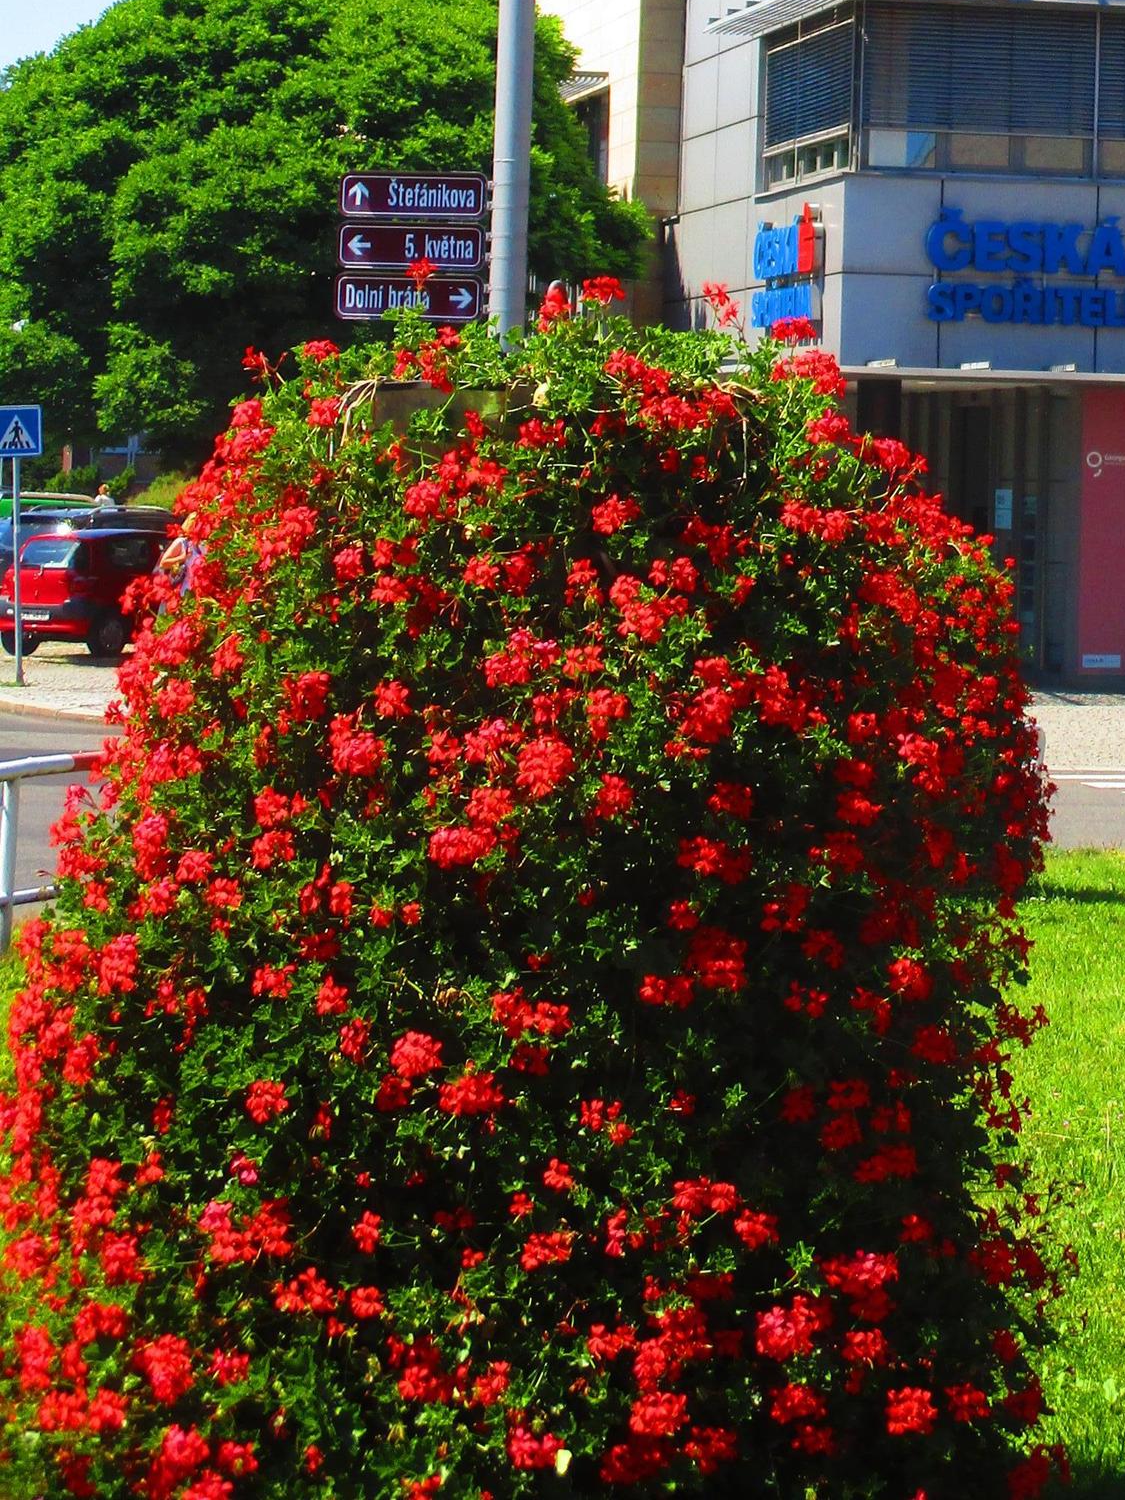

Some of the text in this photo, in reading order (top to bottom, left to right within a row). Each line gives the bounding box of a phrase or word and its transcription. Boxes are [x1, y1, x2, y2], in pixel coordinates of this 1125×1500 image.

[388, 178, 475, 208] Štefánikova
[405, 233, 473, 259] 5. května
[345, 284, 429, 310] Dolní brána
